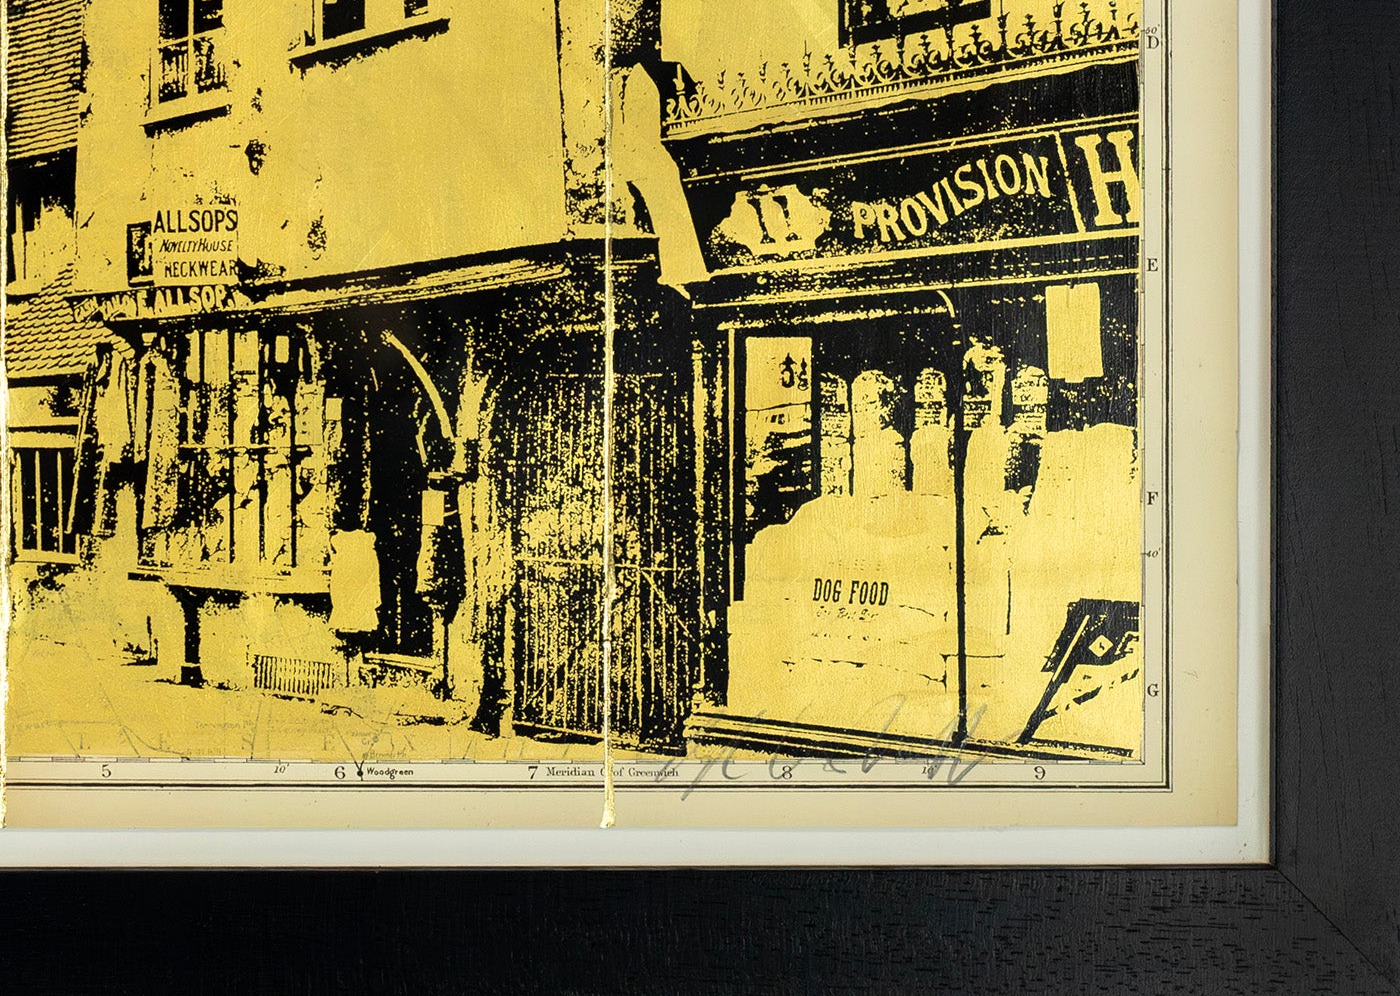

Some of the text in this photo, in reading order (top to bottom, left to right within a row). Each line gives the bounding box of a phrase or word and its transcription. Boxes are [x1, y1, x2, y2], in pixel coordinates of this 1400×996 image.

[851, 152, 1051, 243] PROVISION
[152, 209, 239, 234] ALLSOPS
[812, 578, 889, 606] DOG FOOD
[101, 764, 113, 778] 5
[334, 765, 414, 780] 6 Woodgreen
[527, 765, 539, 780] 7
[545, 767, 596, 778] Meridian
[781, 766, 794, 780] 8
[1034, 765, 1047, 781] 9
